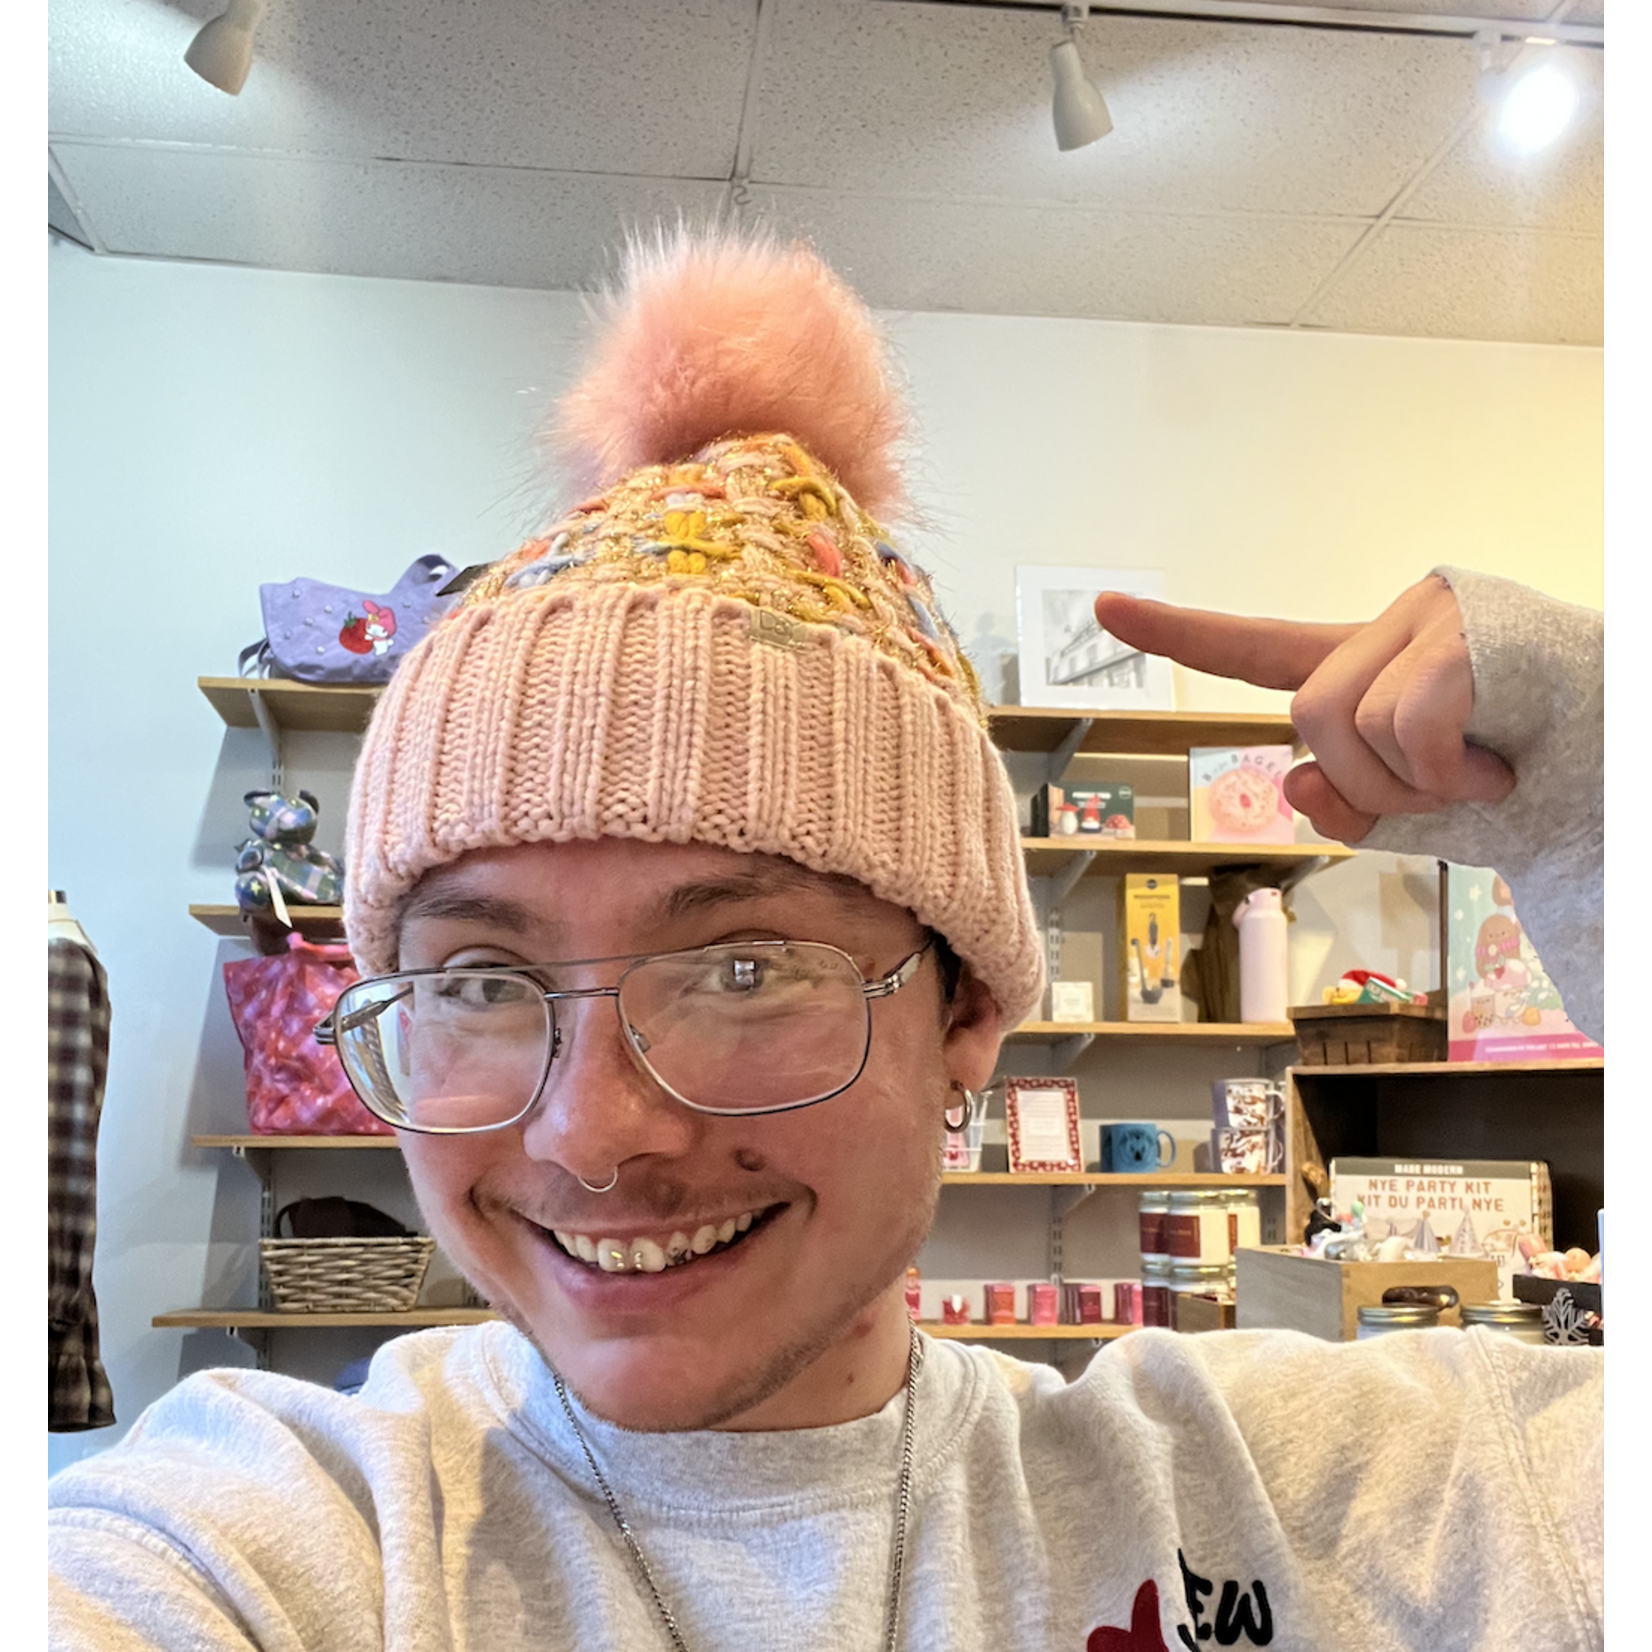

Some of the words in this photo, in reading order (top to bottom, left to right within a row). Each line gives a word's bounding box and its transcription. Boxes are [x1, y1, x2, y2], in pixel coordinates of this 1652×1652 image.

[1422, 1164, 1464, 1176] MODERN
[1368, 1178, 1399, 1193] NYE
[1405, 1179, 1457, 1194] PARTY
[1464, 1181, 1492, 1195] KIT
[1388, 1195, 1409, 1209] DU
[1471, 1198, 1505, 1213] NYE
